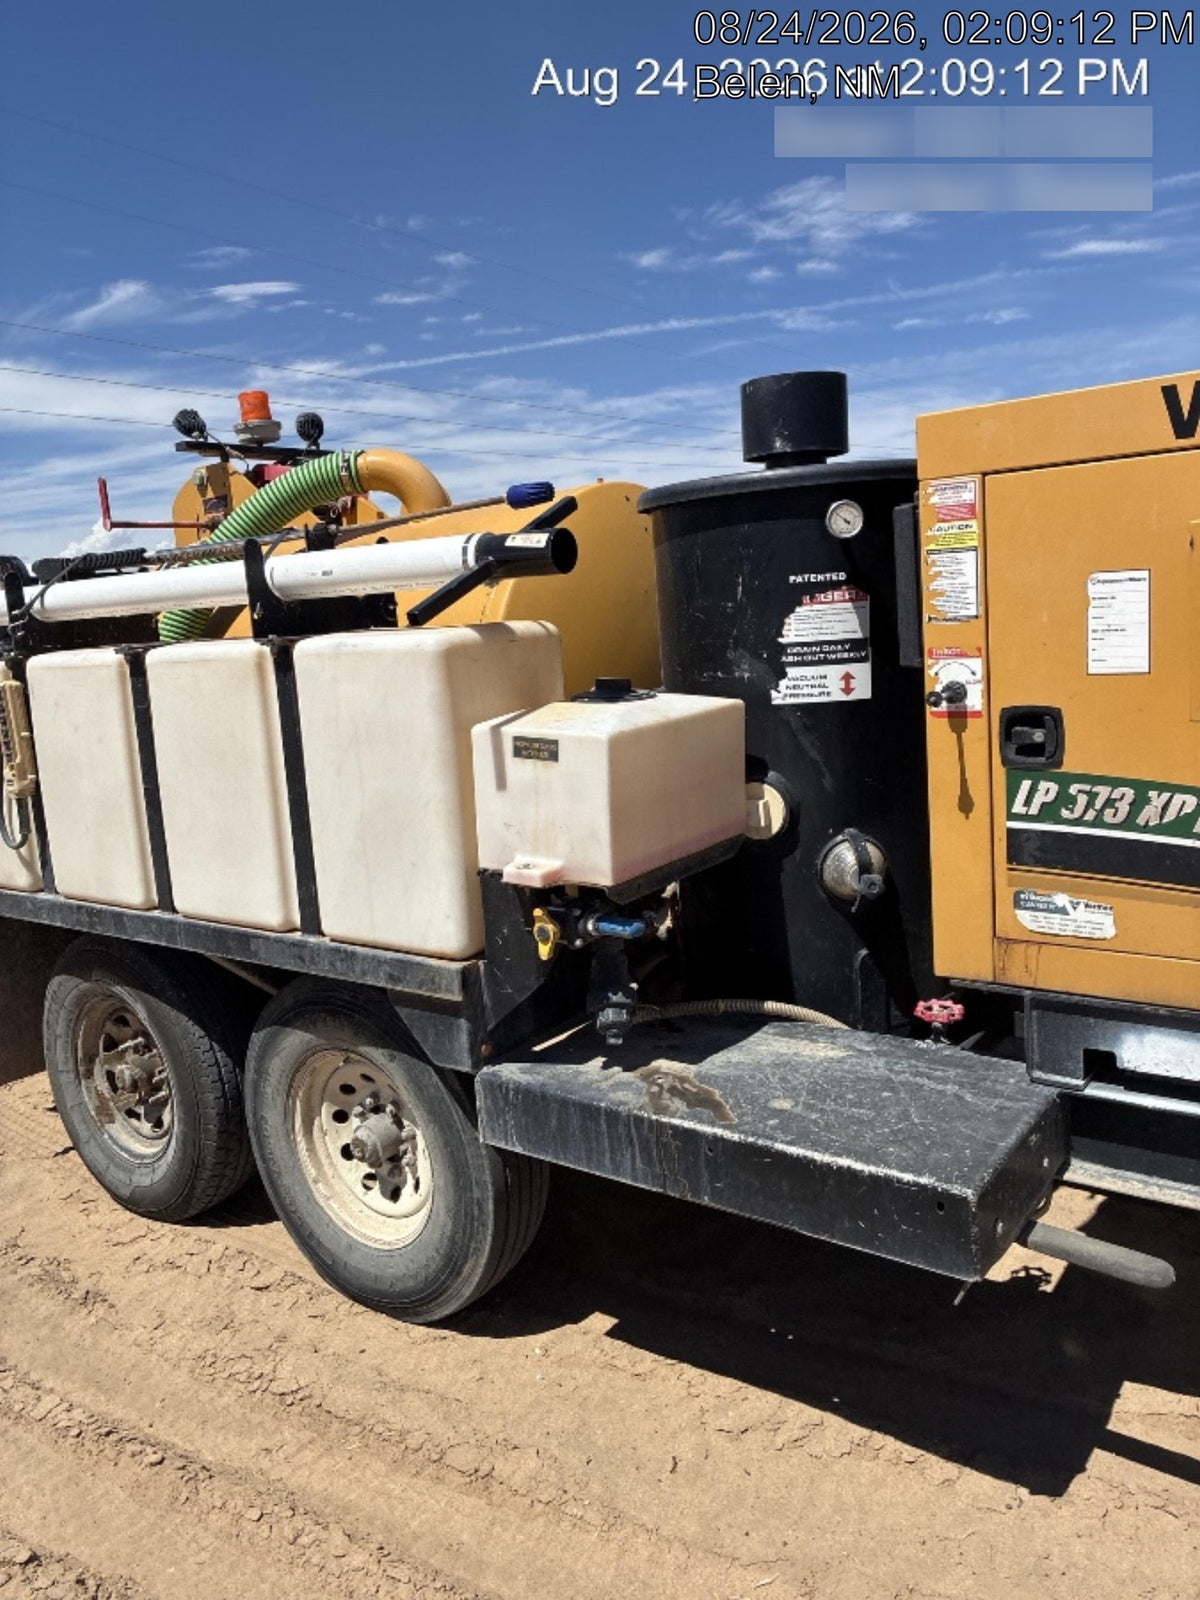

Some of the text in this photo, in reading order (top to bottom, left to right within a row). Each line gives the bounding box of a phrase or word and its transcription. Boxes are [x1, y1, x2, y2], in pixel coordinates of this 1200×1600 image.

[788, 572, 847, 584] PATENTED
[787, 643, 851, 653] DRAIN DAILY
[780, 650, 867, 662] ASH OUT WEEKLY
[787, 673, 828, 681] VACUUM
[782, 691, 832, 700] PRESSURE
[1011, 780, 1059, 815] LP
[1060, 783, 1135, 824] 573
